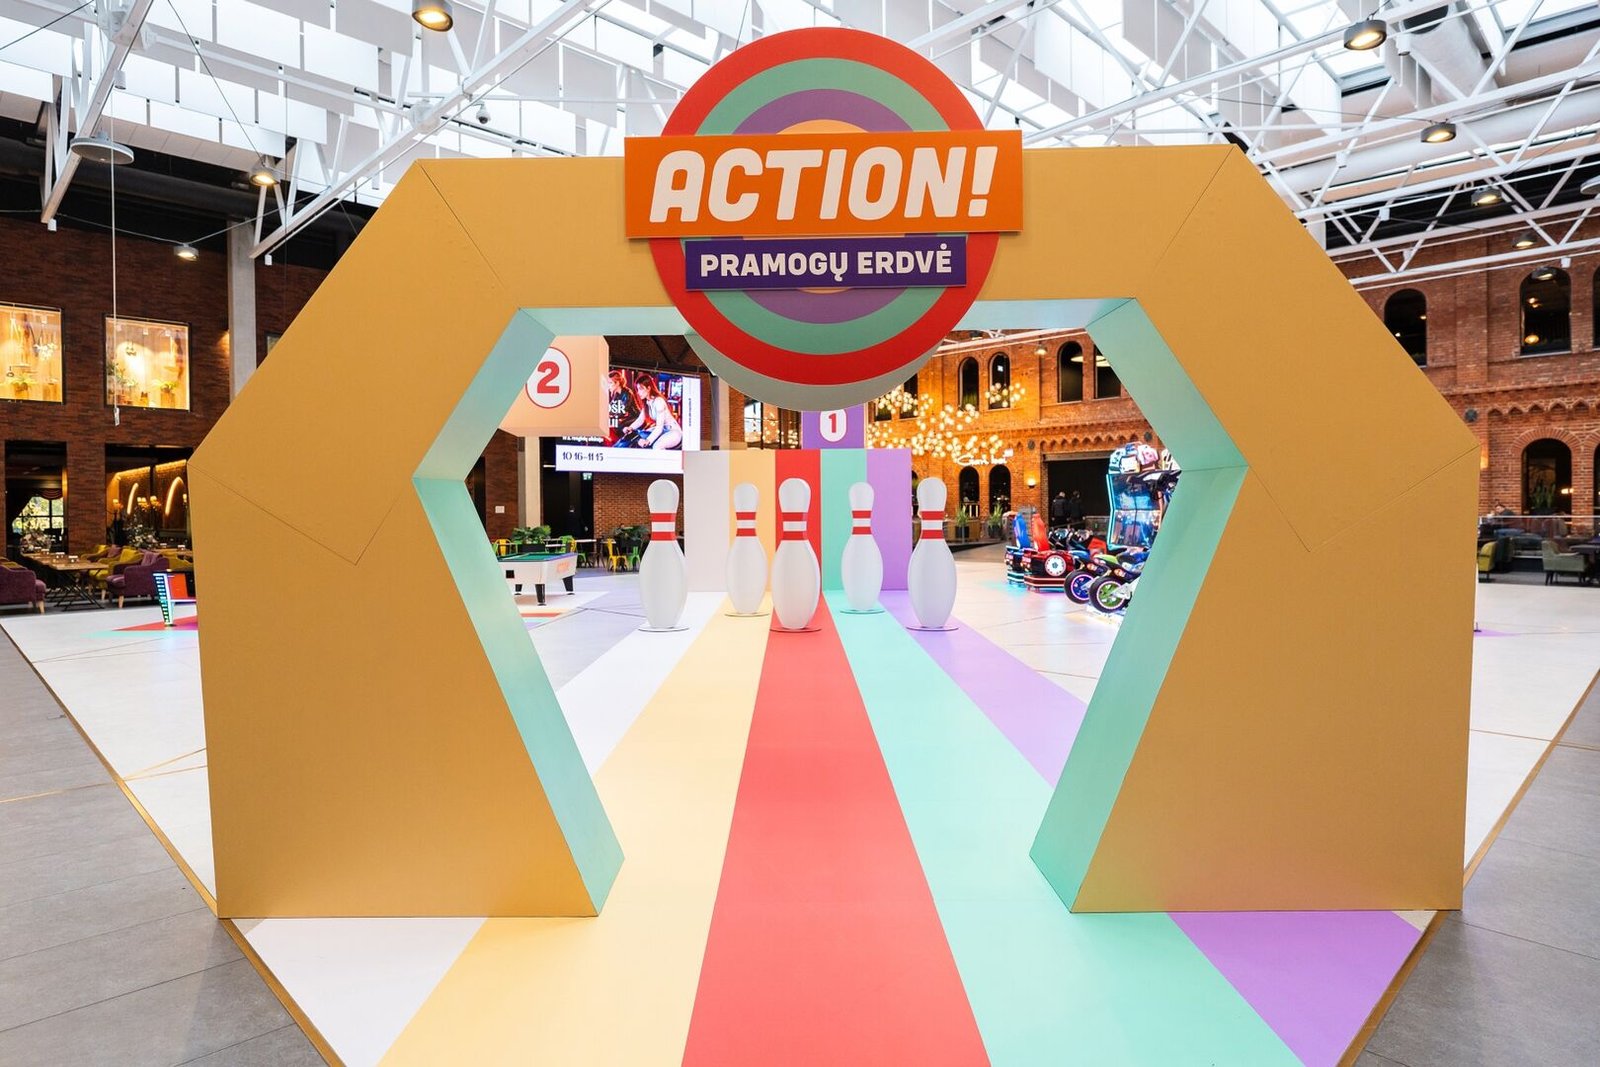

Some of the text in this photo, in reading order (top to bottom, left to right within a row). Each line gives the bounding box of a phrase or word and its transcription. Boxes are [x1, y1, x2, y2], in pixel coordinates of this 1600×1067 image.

[649, 146, 998, 223] ACTION!
[701, 243, 952, 282] PRAMOGŲ ERDVĖ
[537, 361, 560, 394] 2
[828, 413, 837, 433] 1
